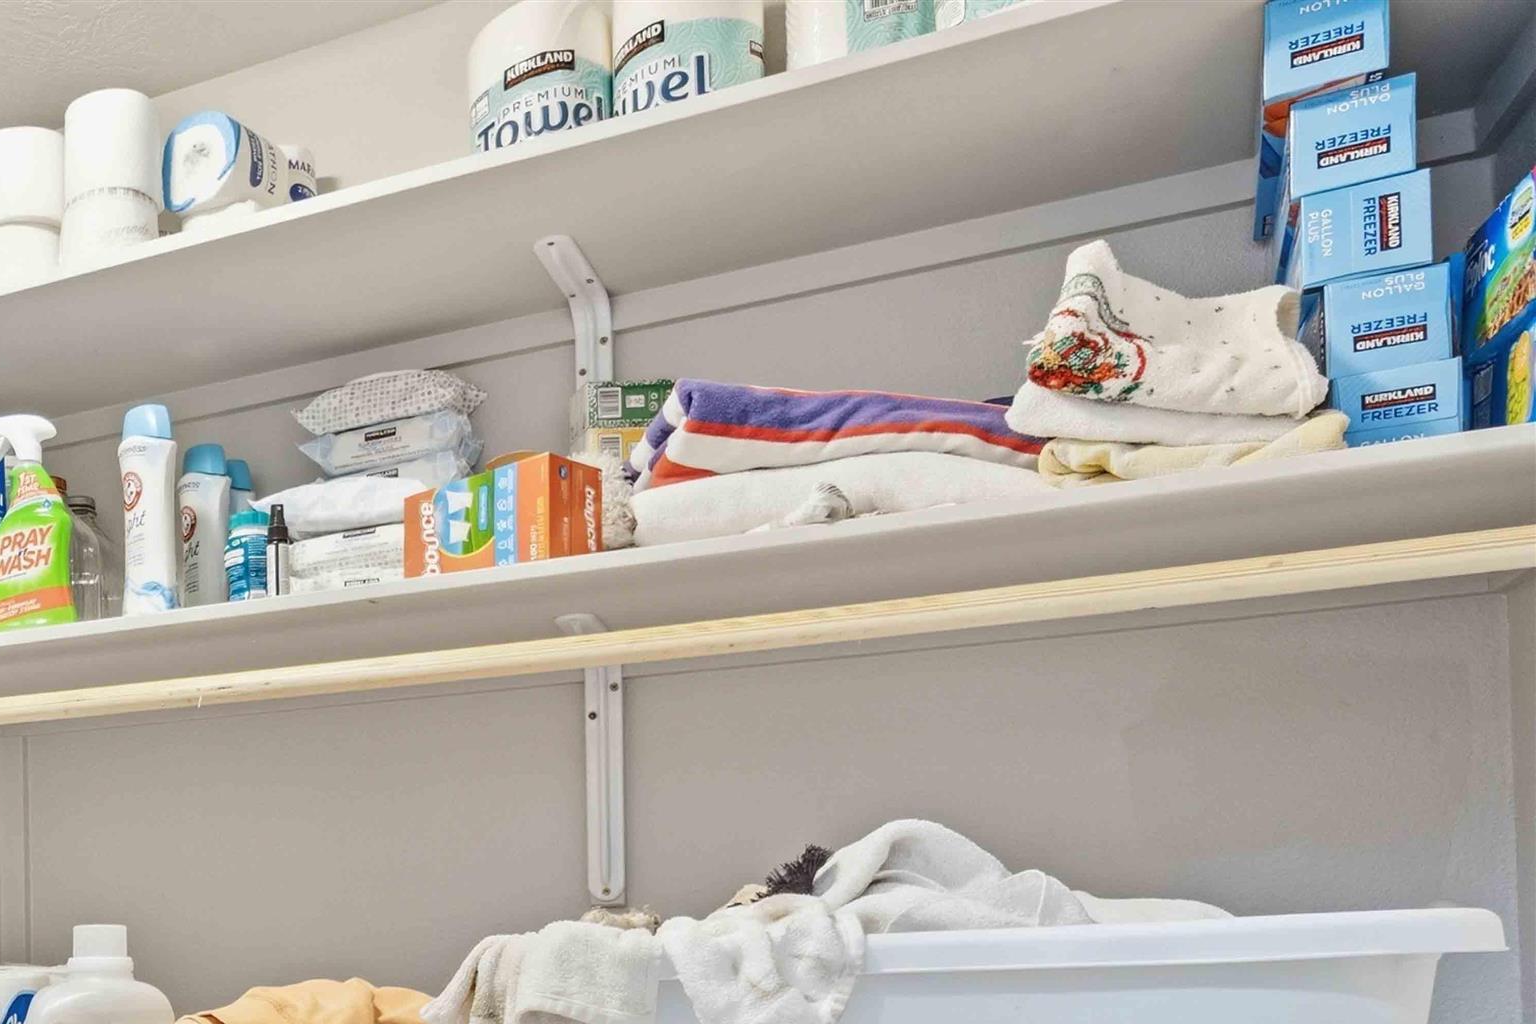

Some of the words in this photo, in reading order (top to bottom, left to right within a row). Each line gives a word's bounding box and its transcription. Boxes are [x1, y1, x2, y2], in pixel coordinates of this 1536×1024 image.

[1289, 21, 1364, 50] FREEZER
[1293, 40, 1360, 65] KIRKLAND
[506, 51, 573, 81] KIRKLAND
[502, 87, 584, 118] PREMIUM
[1350, 84, 1390, 98] PLUS
[1327, 93, 1390, 115] GALLON
[1315, 124, 1391, 150] FREEZER
[1319, 143, 1387, 167] KIRKLAND
[1307, 211, 1319, 244] PLUS
[1321, 208, 1333, 257] GALLON
[1363, 197, 1377, 256] FREEZER
[1387, 194, 1402, 248] KIRKLAND
[1361, 281, 1425, 301] GALLON
[1384, 271, 1425, 287] PLUS
[1351, 312, 1428, 334] FREEZER
[1356, 330, 1425, 350] KIRKLAND
[1365, 385, 1434, 404] KIRKLAND
[1361, 402, 1439, 423] FREEZER
[421, 502, 440, 576] bounce
